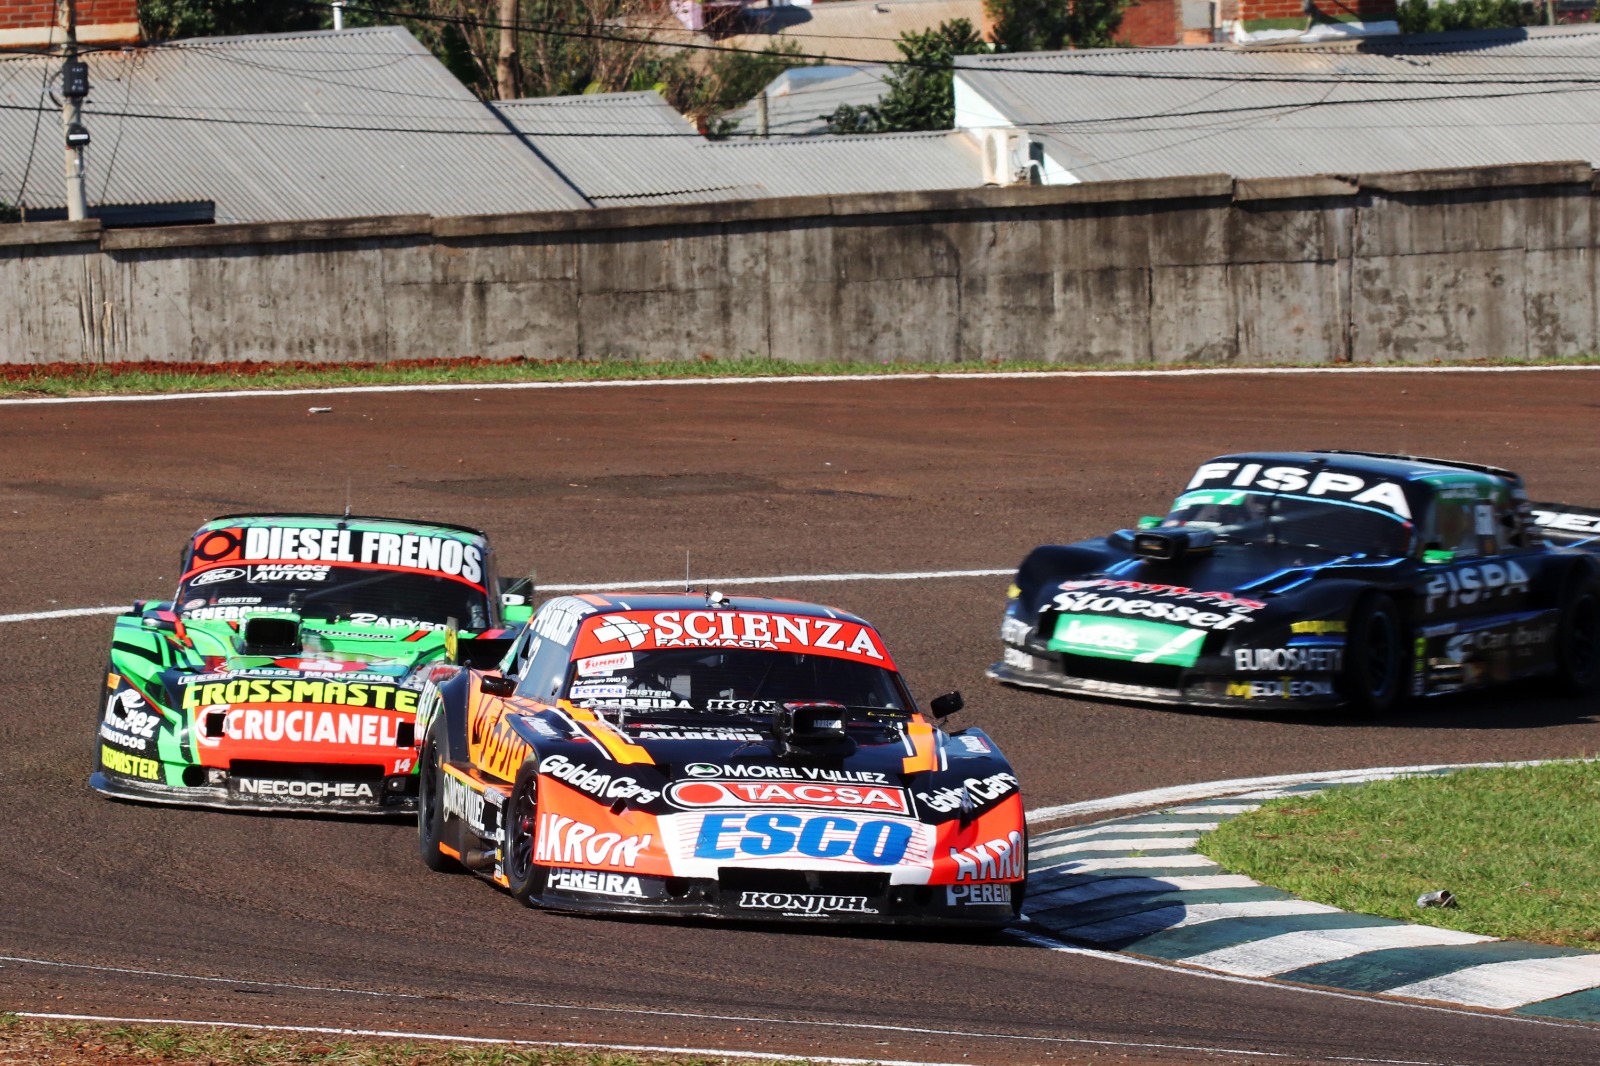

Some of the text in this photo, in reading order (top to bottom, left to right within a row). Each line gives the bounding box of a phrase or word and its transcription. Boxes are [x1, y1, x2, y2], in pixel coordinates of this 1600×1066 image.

[1185, 462, 1412, 520] FISPA
[245, 527, 482, 583] DIESEL FRENOS
[251, 571, 327, 581] AUTOS
[1426, 560, 1530, 613] FISPA
[1053, 591, 1246, 630] Stoessel
[653, 612, 884, 660] SCIENZA
[656, 639, 778, 649] FARMACIA
[304, 671, 394, 682] MANZANA
[575, 686, 623, 694] Ferrea
[183, 680, 418, 713] CROSSMASTE
[229, 709, 411, 749] CRUCIANEL
[639, 732, 763, 741] ALLOCHIS
[394, 759, 410, 773] 14
[540, 755, 661, 803] Golden Cars
[724, 764, 888, 783] MOREL VULLIEZ
[239, 778, 373, 797] NECOCHEA
[738, 784, 904, 807] TACSA
[916, 772, 1019, 813] Goldn Cars
[535, 813, 652, 867] AKRON
[694, 813, 913, 866] ESCO
[949, 830, 1021, 880] AKRO
[548, 868, 643, 896] PEREIRA
[946, 883, 1012, 906] PEREIR
[739, 892, 867, 913] KONJUH
